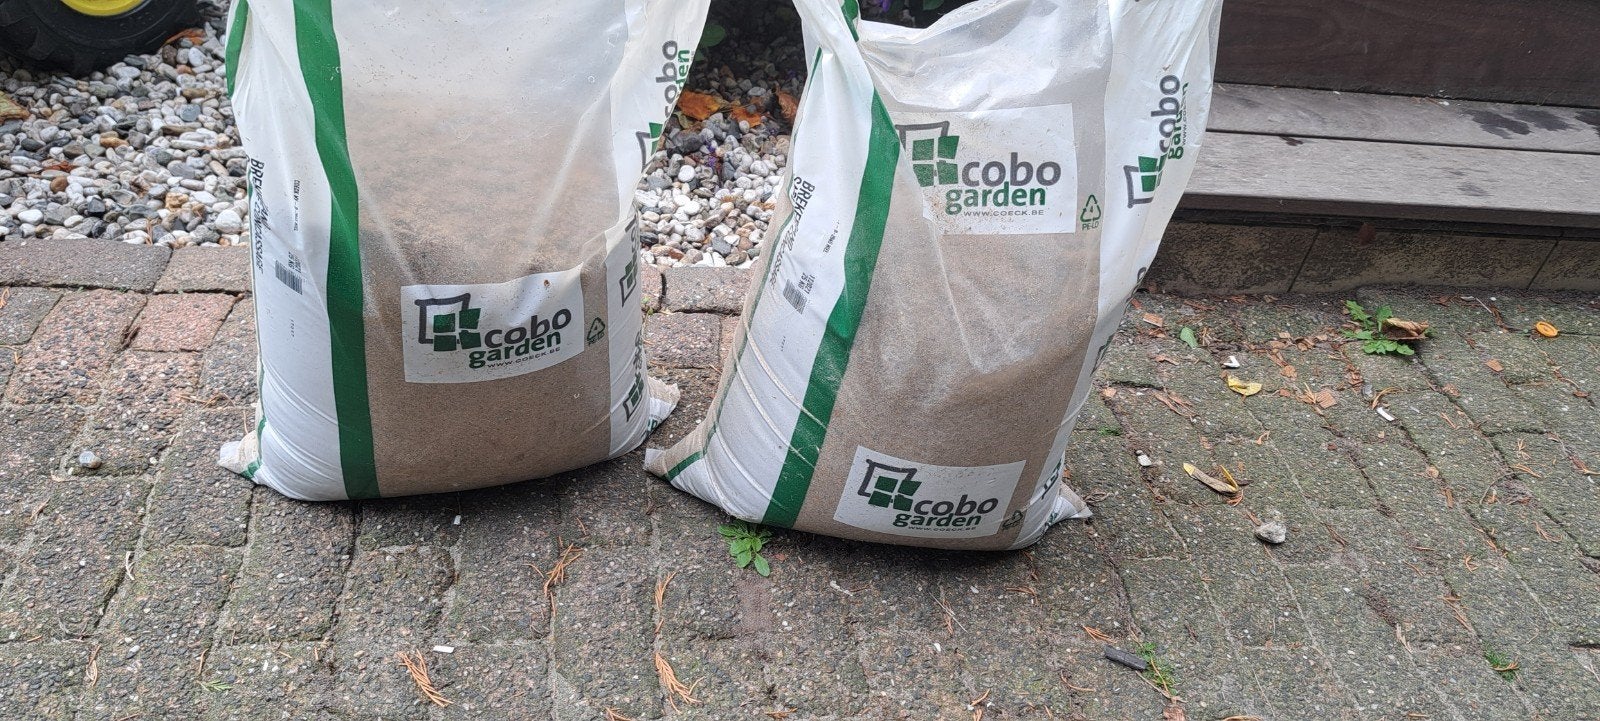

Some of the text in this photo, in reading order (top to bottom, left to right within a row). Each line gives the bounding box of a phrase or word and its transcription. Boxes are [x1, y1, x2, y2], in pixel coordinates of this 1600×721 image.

[1150, 74, 1180, 154] cobo
[961, 151, 1062, 188] cobo
[944, 180, 1047, 216] garden
[963, 209, 1045, 217] WWW.COECK.BE
[483, 308, 572, 349] cobo
[468, 331, 562, 369] garden
[487, 346, 562, 368] WWW.COECK.BE
[892, 512, 982, 528] garden
[913, 494, 999, 517] cobo
